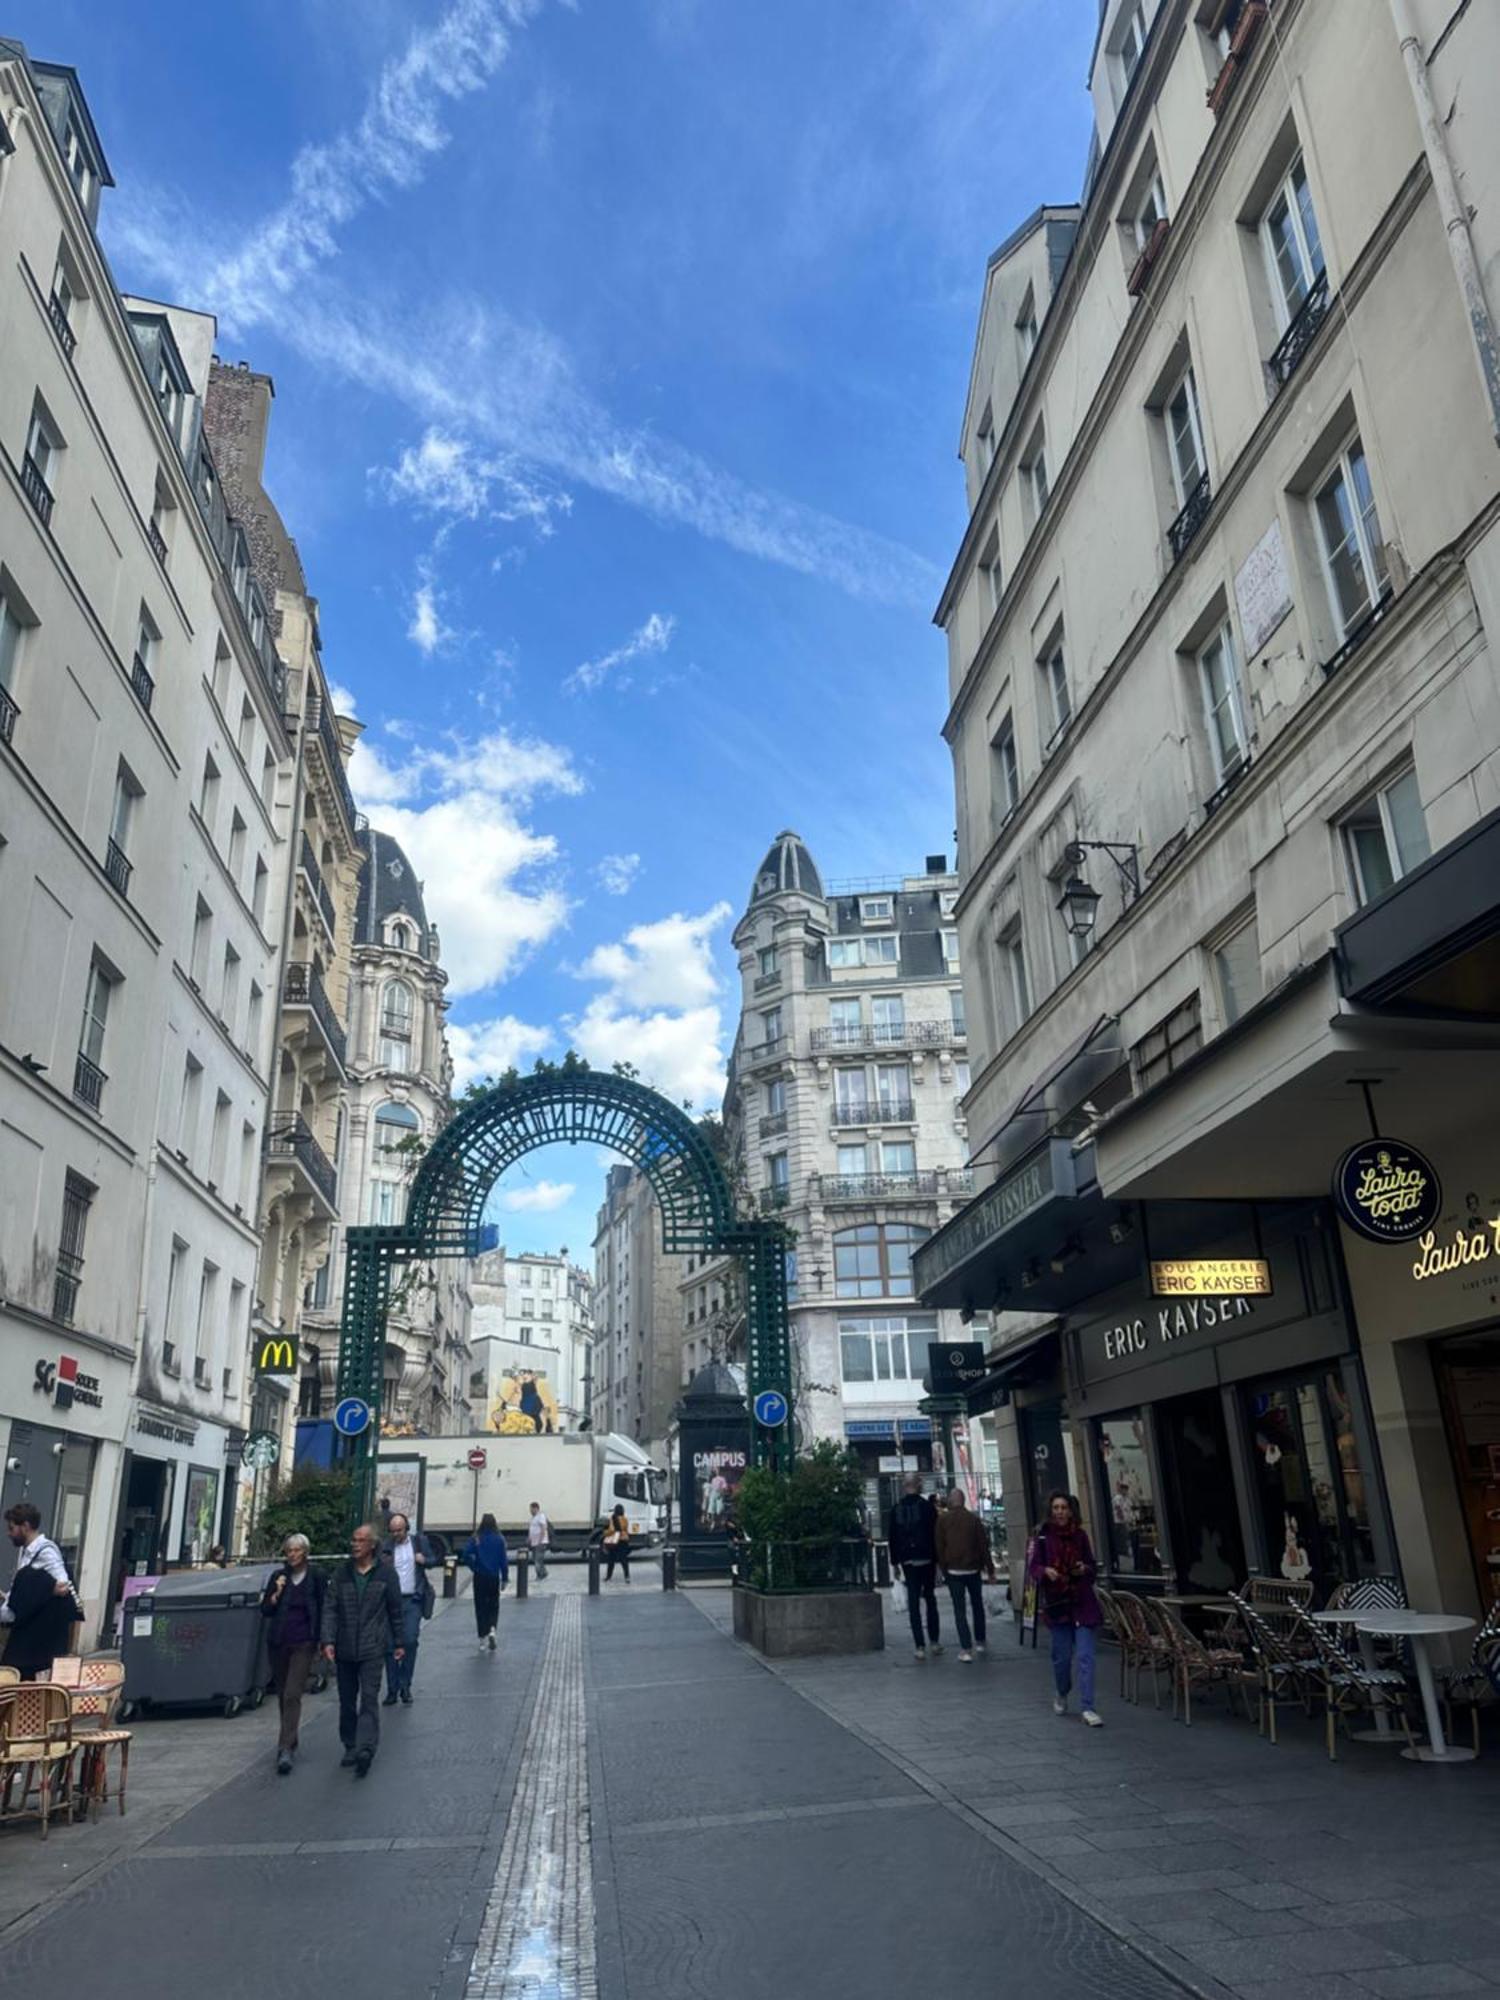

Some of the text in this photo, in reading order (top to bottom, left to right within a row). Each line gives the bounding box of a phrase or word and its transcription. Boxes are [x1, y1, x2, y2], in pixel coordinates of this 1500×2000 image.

[1356, 1167, 1426, 1200] Laura
[1359, 1187, 1423, 1218] todd
[1154, 1263, 1265, 1274] BOULANGERIE
[1413, 1230, 1490, 1280] Laura
[1157, 1276, 1266, 1291] ERIC KAYSER
[1104, 1320, 1146, 1360] ERIC
[33, 1359, 55, 1394] SG
[693, 1452, 746, 1468] CAMPUS
